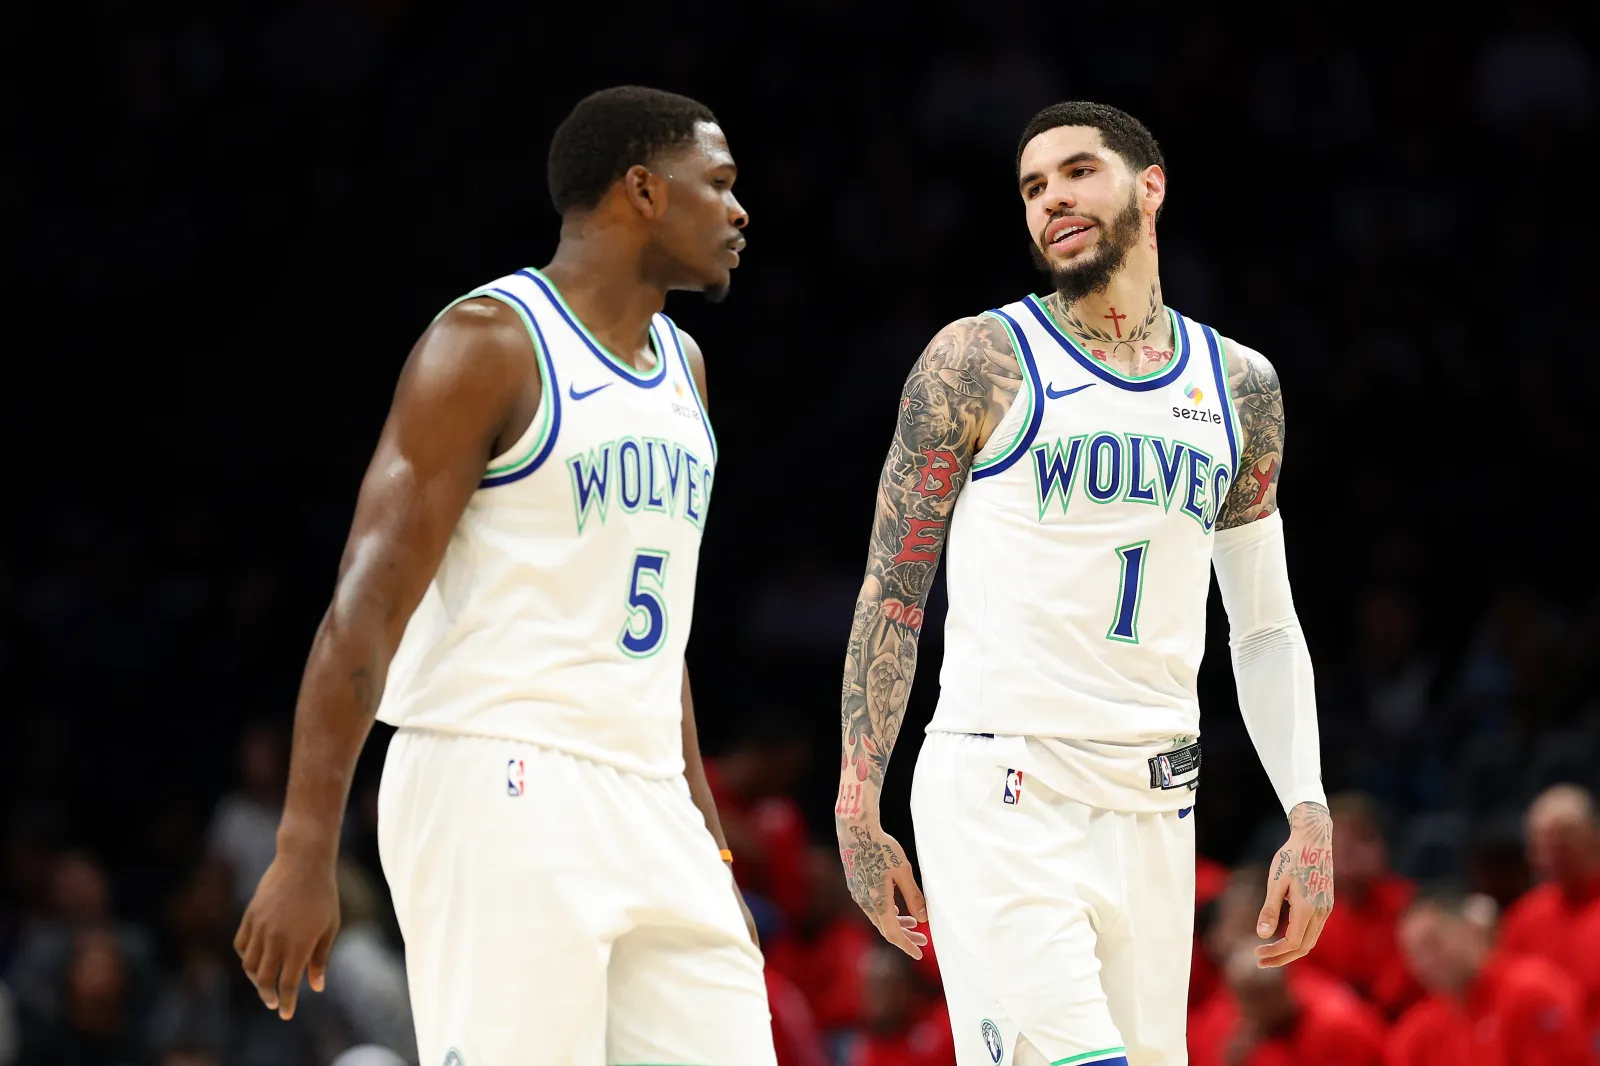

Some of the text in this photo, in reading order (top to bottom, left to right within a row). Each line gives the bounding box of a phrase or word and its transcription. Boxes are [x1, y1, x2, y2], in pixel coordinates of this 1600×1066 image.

[1172, 405, 1221, 425] sezzle
[1029, 430, 1231, 534] WOLVES
[617, 548, 670, 659] 5
[1106, 539, 1150, 645] 1
[1299, 844, 1324, 867] NOT
